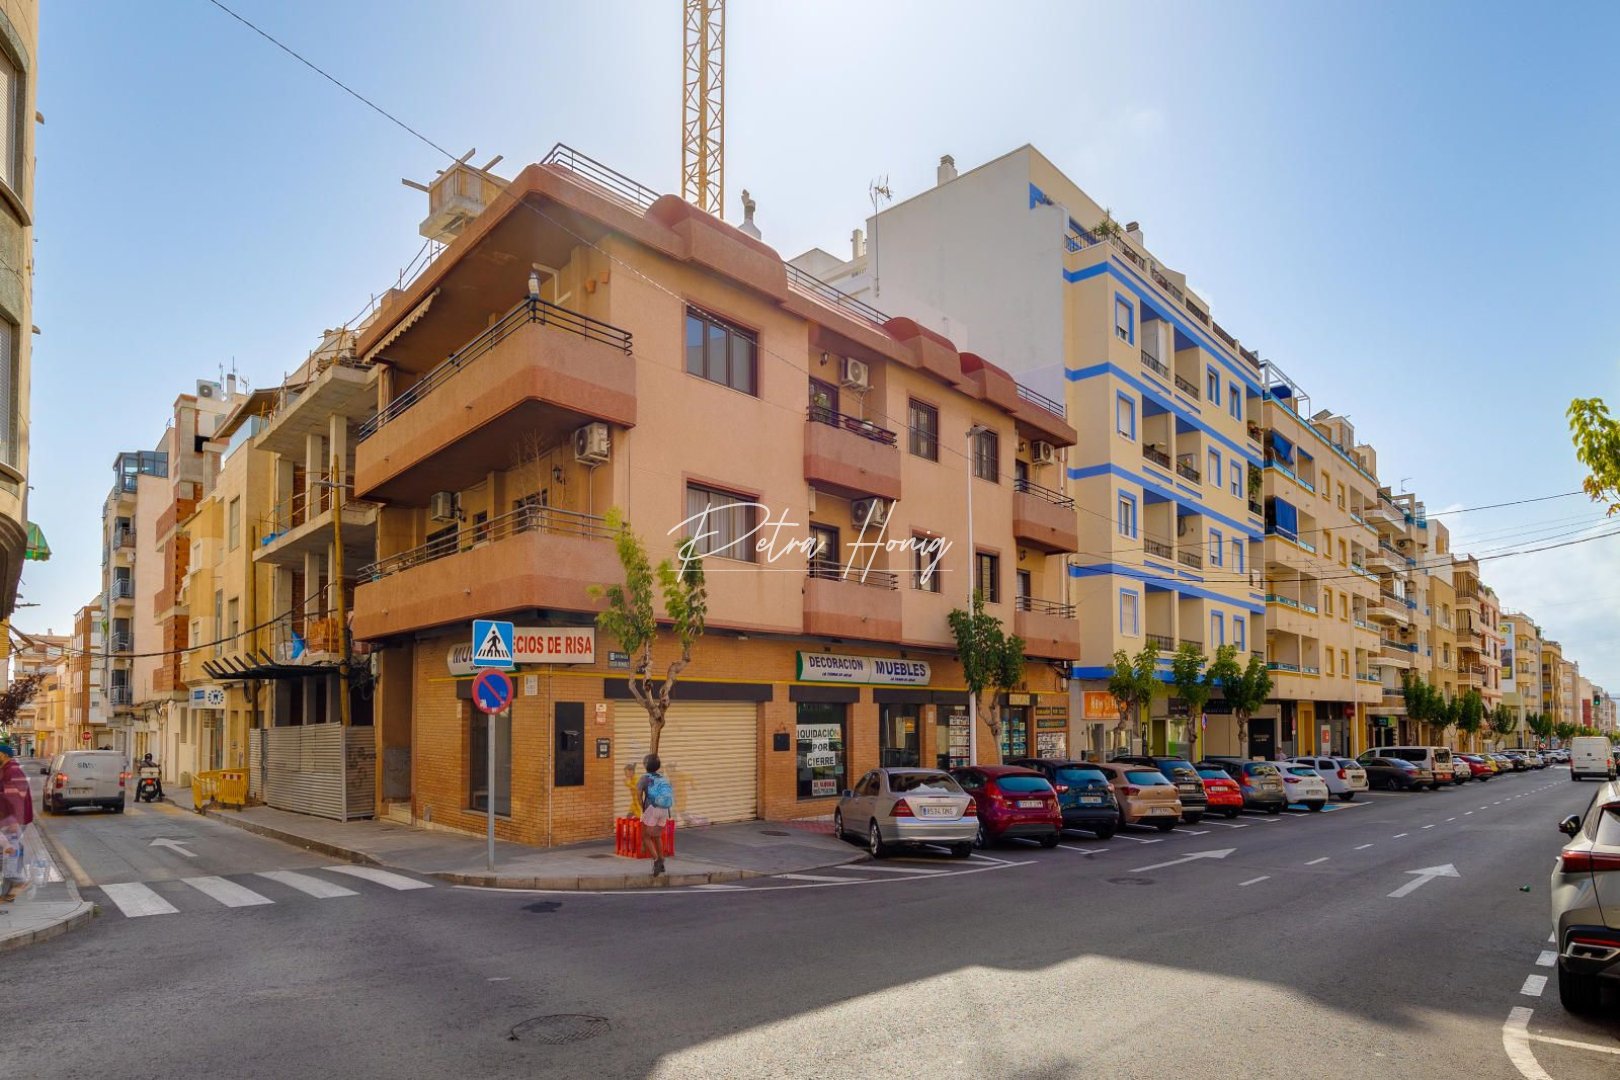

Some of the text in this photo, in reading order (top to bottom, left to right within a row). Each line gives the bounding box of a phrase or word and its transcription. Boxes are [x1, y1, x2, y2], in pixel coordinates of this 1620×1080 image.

[547, 636, 561, 654] DE
[565, 636, 592, 654] RISA
[875, 660, 926, 677] MUEBLES
[812, 743, 828, 752] POR
[807, 756, 835, 767] CIERRE
